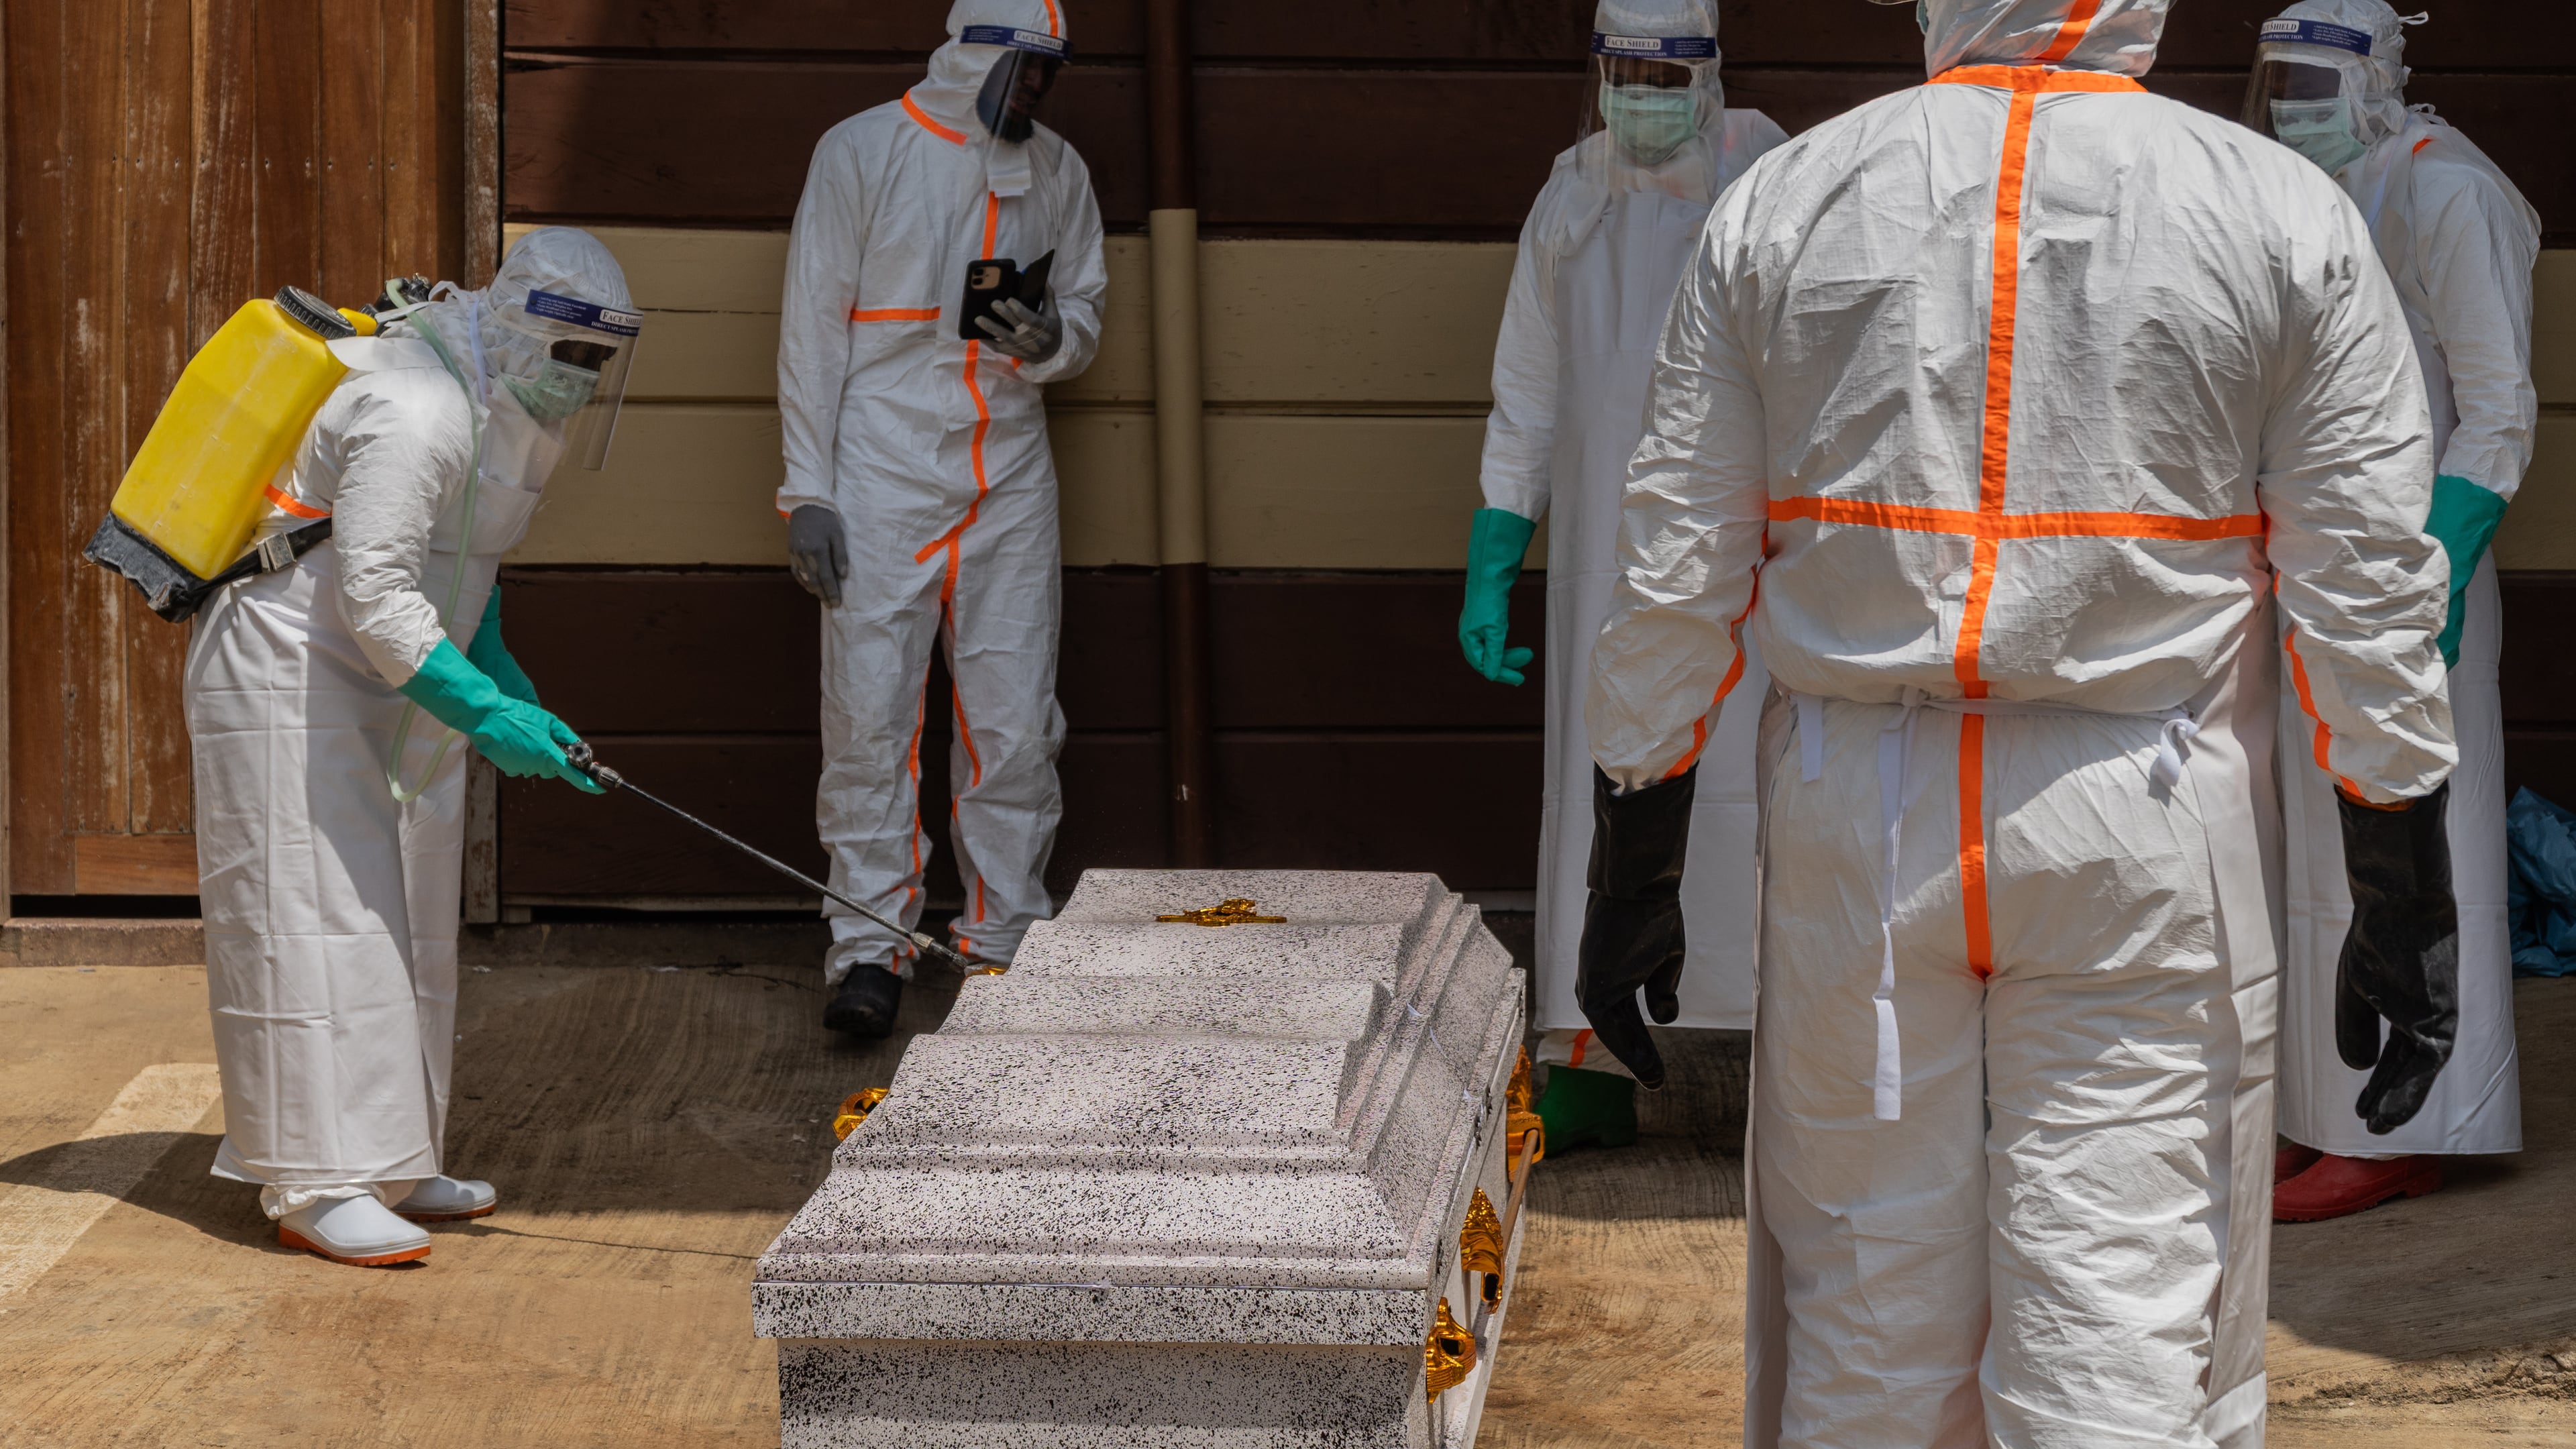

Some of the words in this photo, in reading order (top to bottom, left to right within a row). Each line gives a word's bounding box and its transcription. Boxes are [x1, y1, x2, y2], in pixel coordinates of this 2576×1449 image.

[2270, 21, 2297, 30] SHIELD
[1016, 32, 1036, 42] FACE
[1037, 36, 1062, 49] SHIELD
[1607, 37, 1625, 47] FACE
[1627, 39, 1659, 48] SHIELD
[602, 311, 623, 323] FACE
[591, 321, 611, 330] DIRECT
